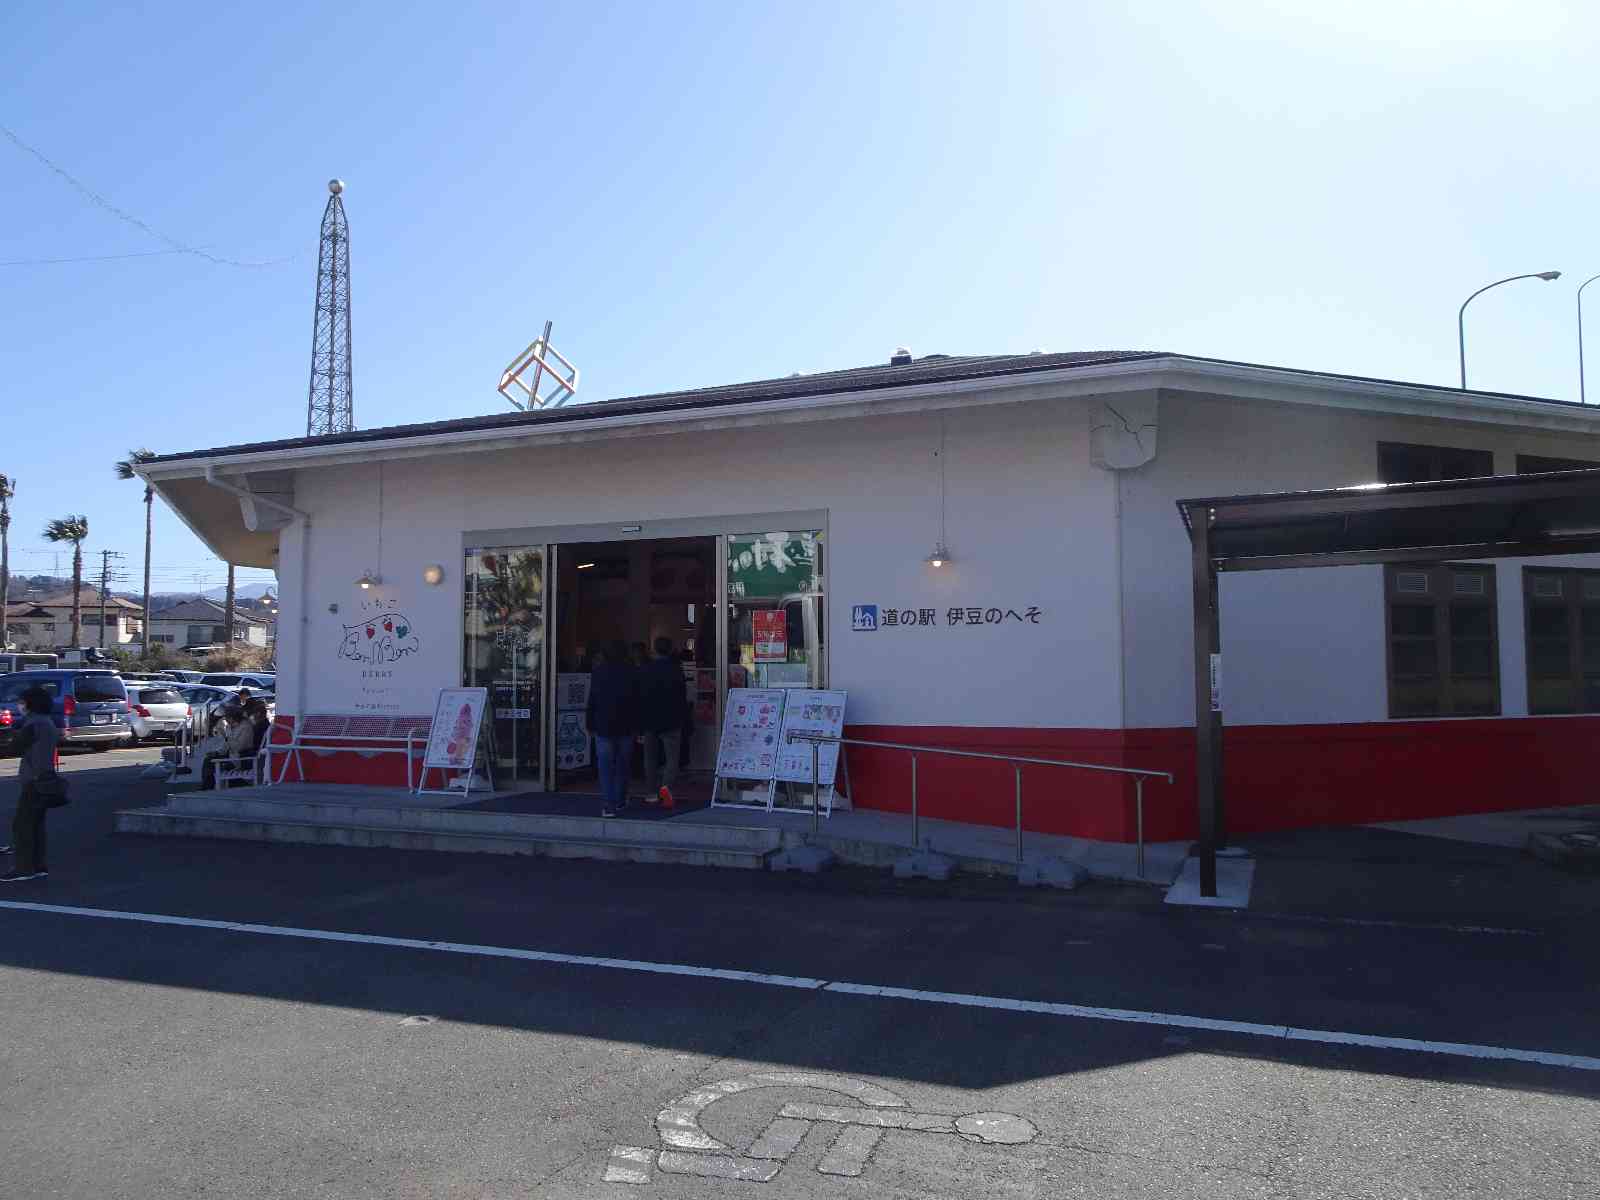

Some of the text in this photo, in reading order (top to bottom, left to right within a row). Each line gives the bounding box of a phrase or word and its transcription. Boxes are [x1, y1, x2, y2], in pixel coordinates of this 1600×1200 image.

[880, 606, 1043, 626] 道の駅 伊豆のへそ
